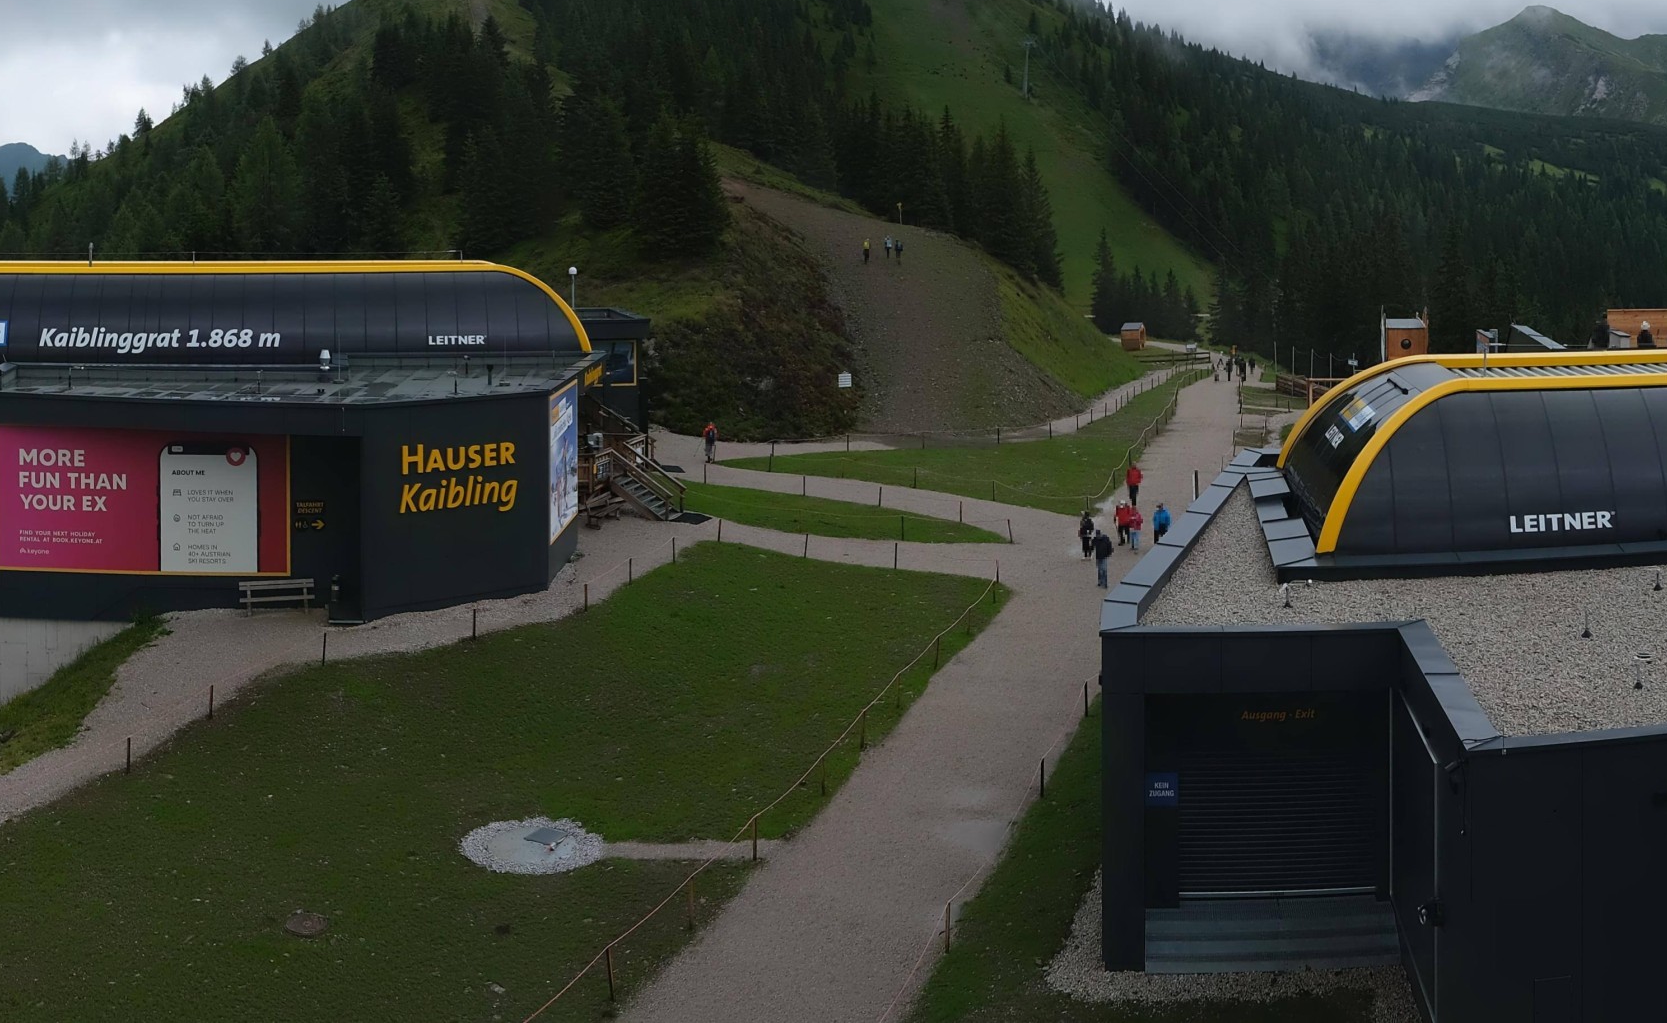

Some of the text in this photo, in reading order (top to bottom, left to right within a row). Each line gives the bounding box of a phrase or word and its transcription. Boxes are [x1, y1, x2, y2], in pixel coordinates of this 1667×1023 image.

[39, 326, 281, 355] Kaiblinggrat 1.868 m
[428, 335, 486, 346] LEITNER
[19, 448, 85, 466] MORE
[18, 472, 127, 490] FUN THAN
[400, 441, 518, 514] HAUSER Kaibling
[20, 494, 107, 512] YOUR EX
[1510, 511, 1612, 533] LEITNER
[1241, 709, 1315, 722] Ausgang Exit
